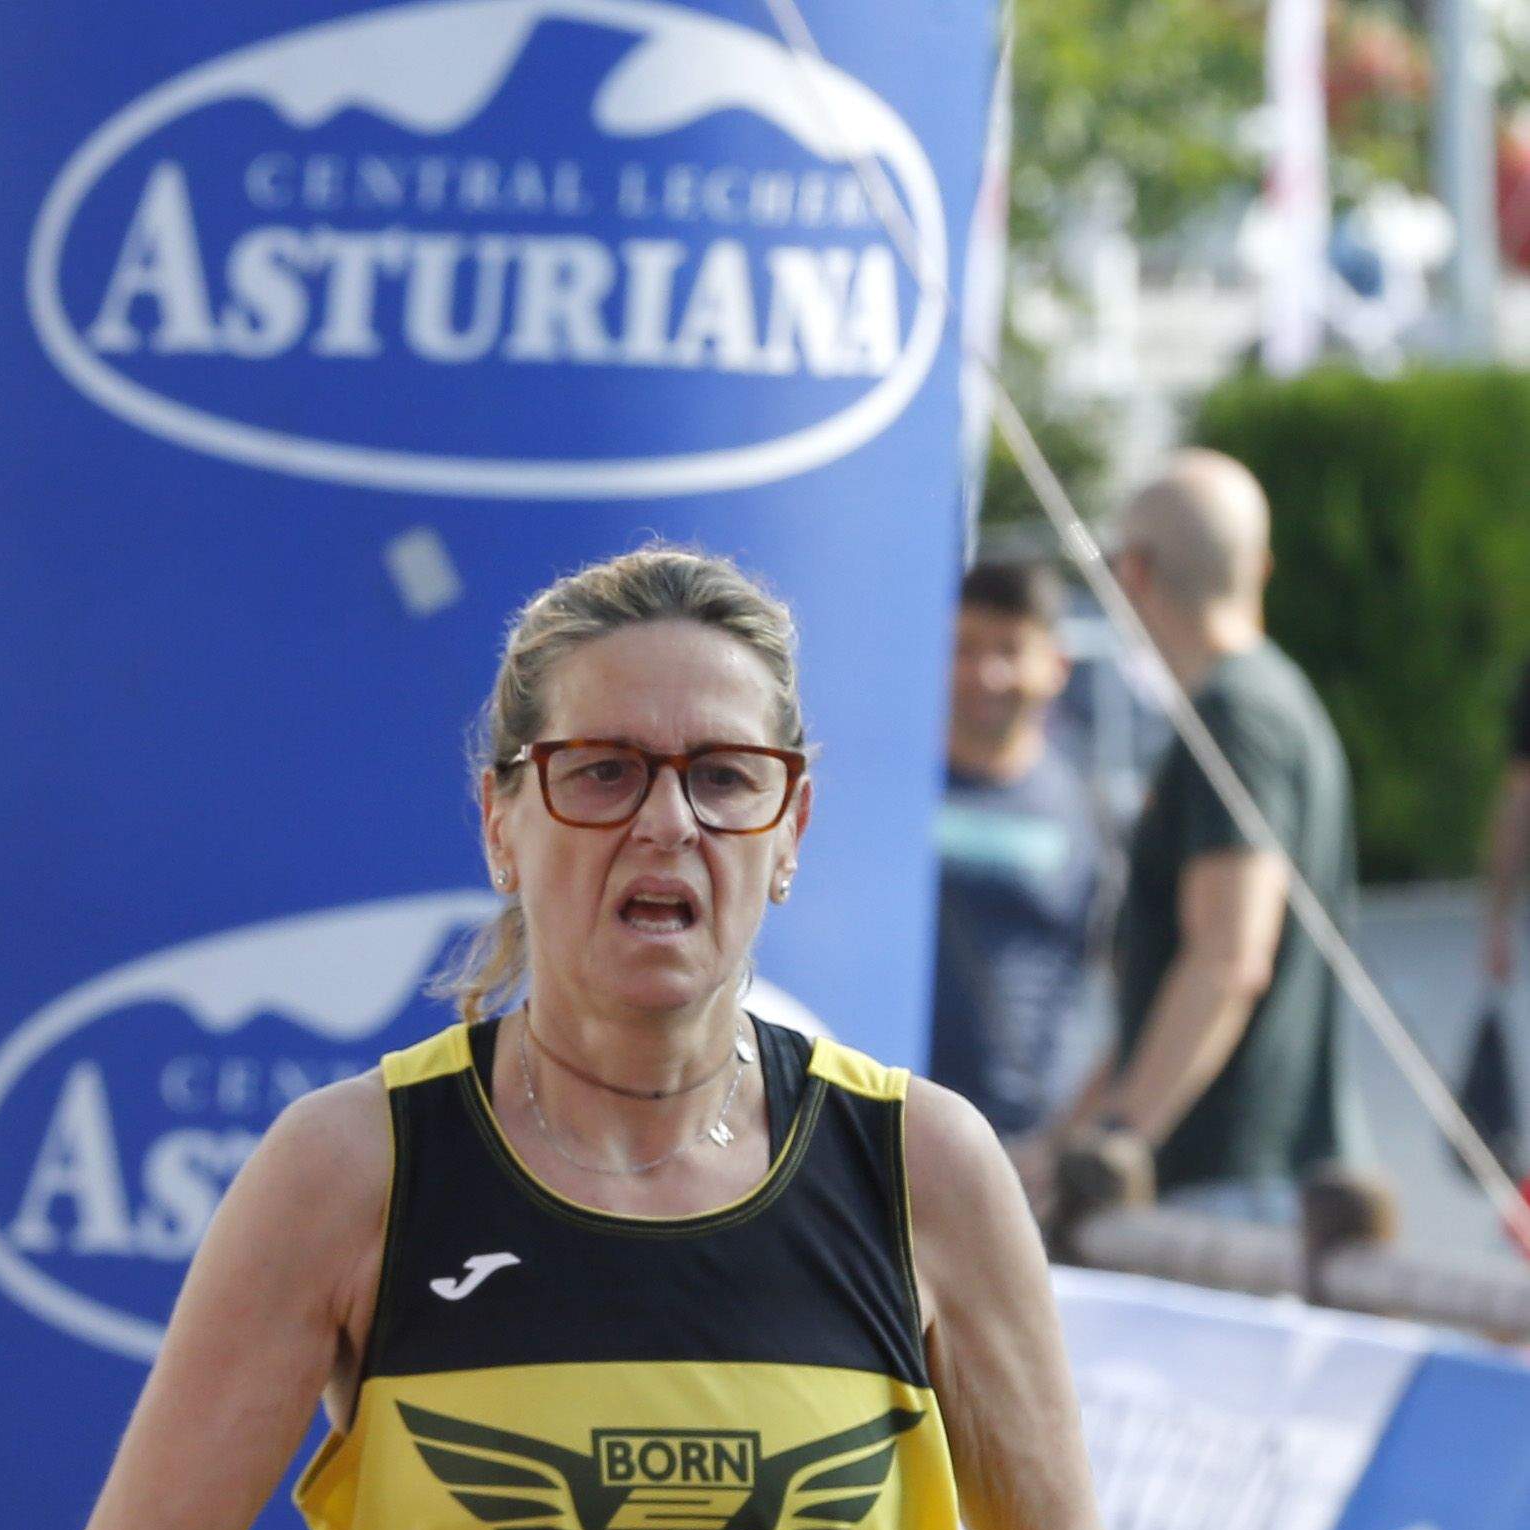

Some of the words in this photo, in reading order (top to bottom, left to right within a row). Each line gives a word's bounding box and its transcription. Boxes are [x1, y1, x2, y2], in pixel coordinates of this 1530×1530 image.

[244, 152, 592, 215] CENTRAL
[86, 157, 902, 380] ASTURIANA
[605, 1440, 748, 1482] BORN
